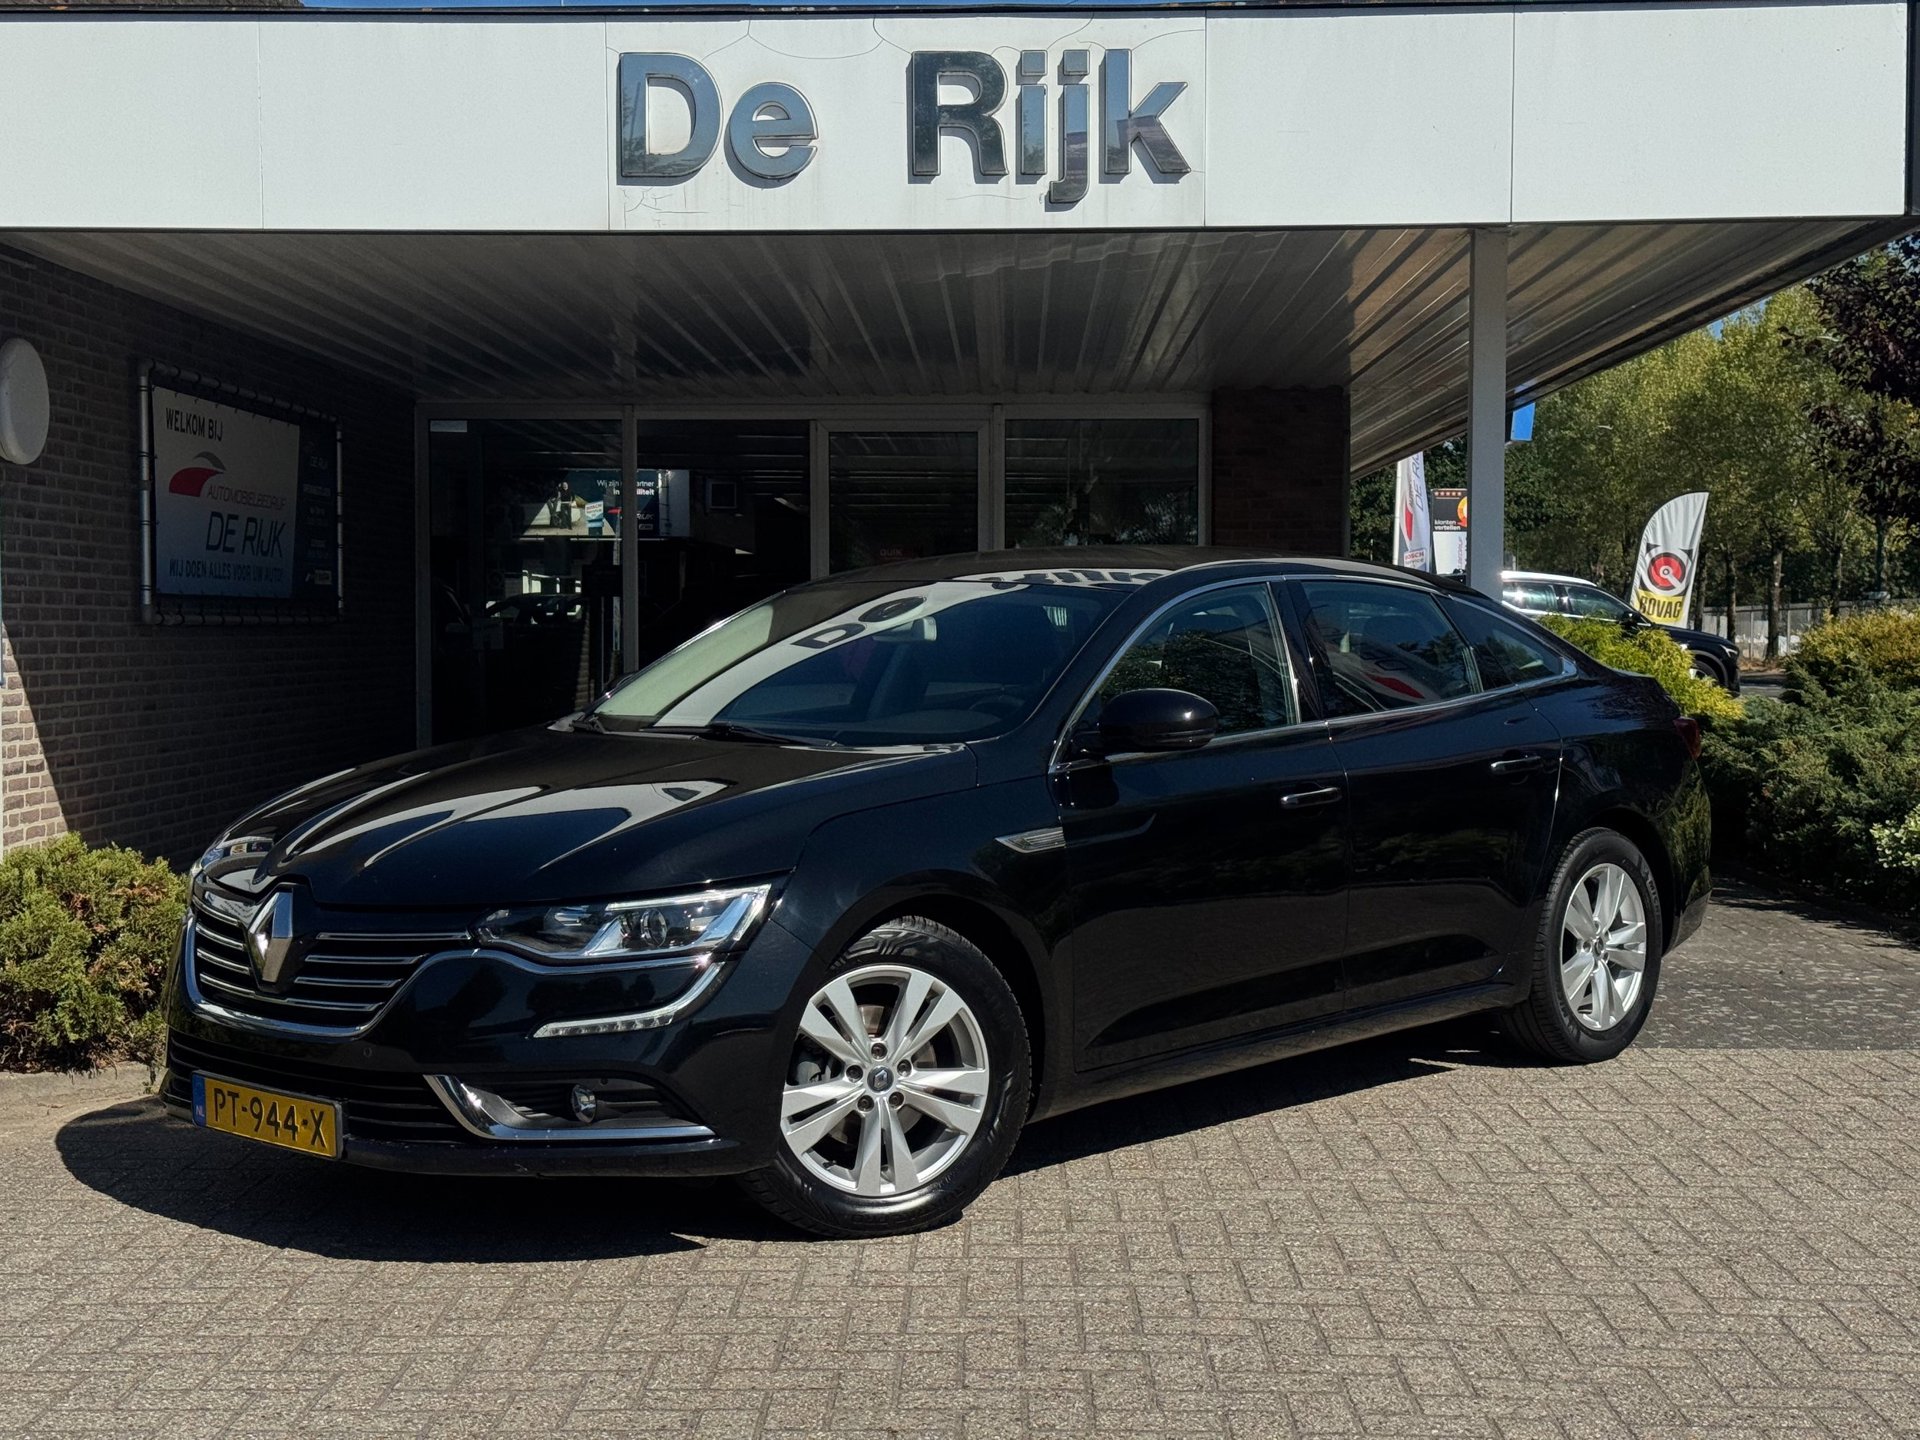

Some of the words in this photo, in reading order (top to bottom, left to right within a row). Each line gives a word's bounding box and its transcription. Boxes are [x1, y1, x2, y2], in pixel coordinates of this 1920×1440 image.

[617, 51, 820, 184] De
[908, 49, 1192, 206] Rijk
[165, 407, 206, 439] WELKOM
[208, 418, 224, 442] BIJ
[205, 510, 239, 552] DE
[241, 516, 286, 558] RIJK
[169, 558, 184, 578] WIJ
[185, 559, 207, 579] DOEN
[209, 561, 231, 581] ALLES
[1639, 595, 1683, 619] BOVAG
[195, 1105, 205, 1118] NL
[213, 1087, 328, 1149] PT-944-X
